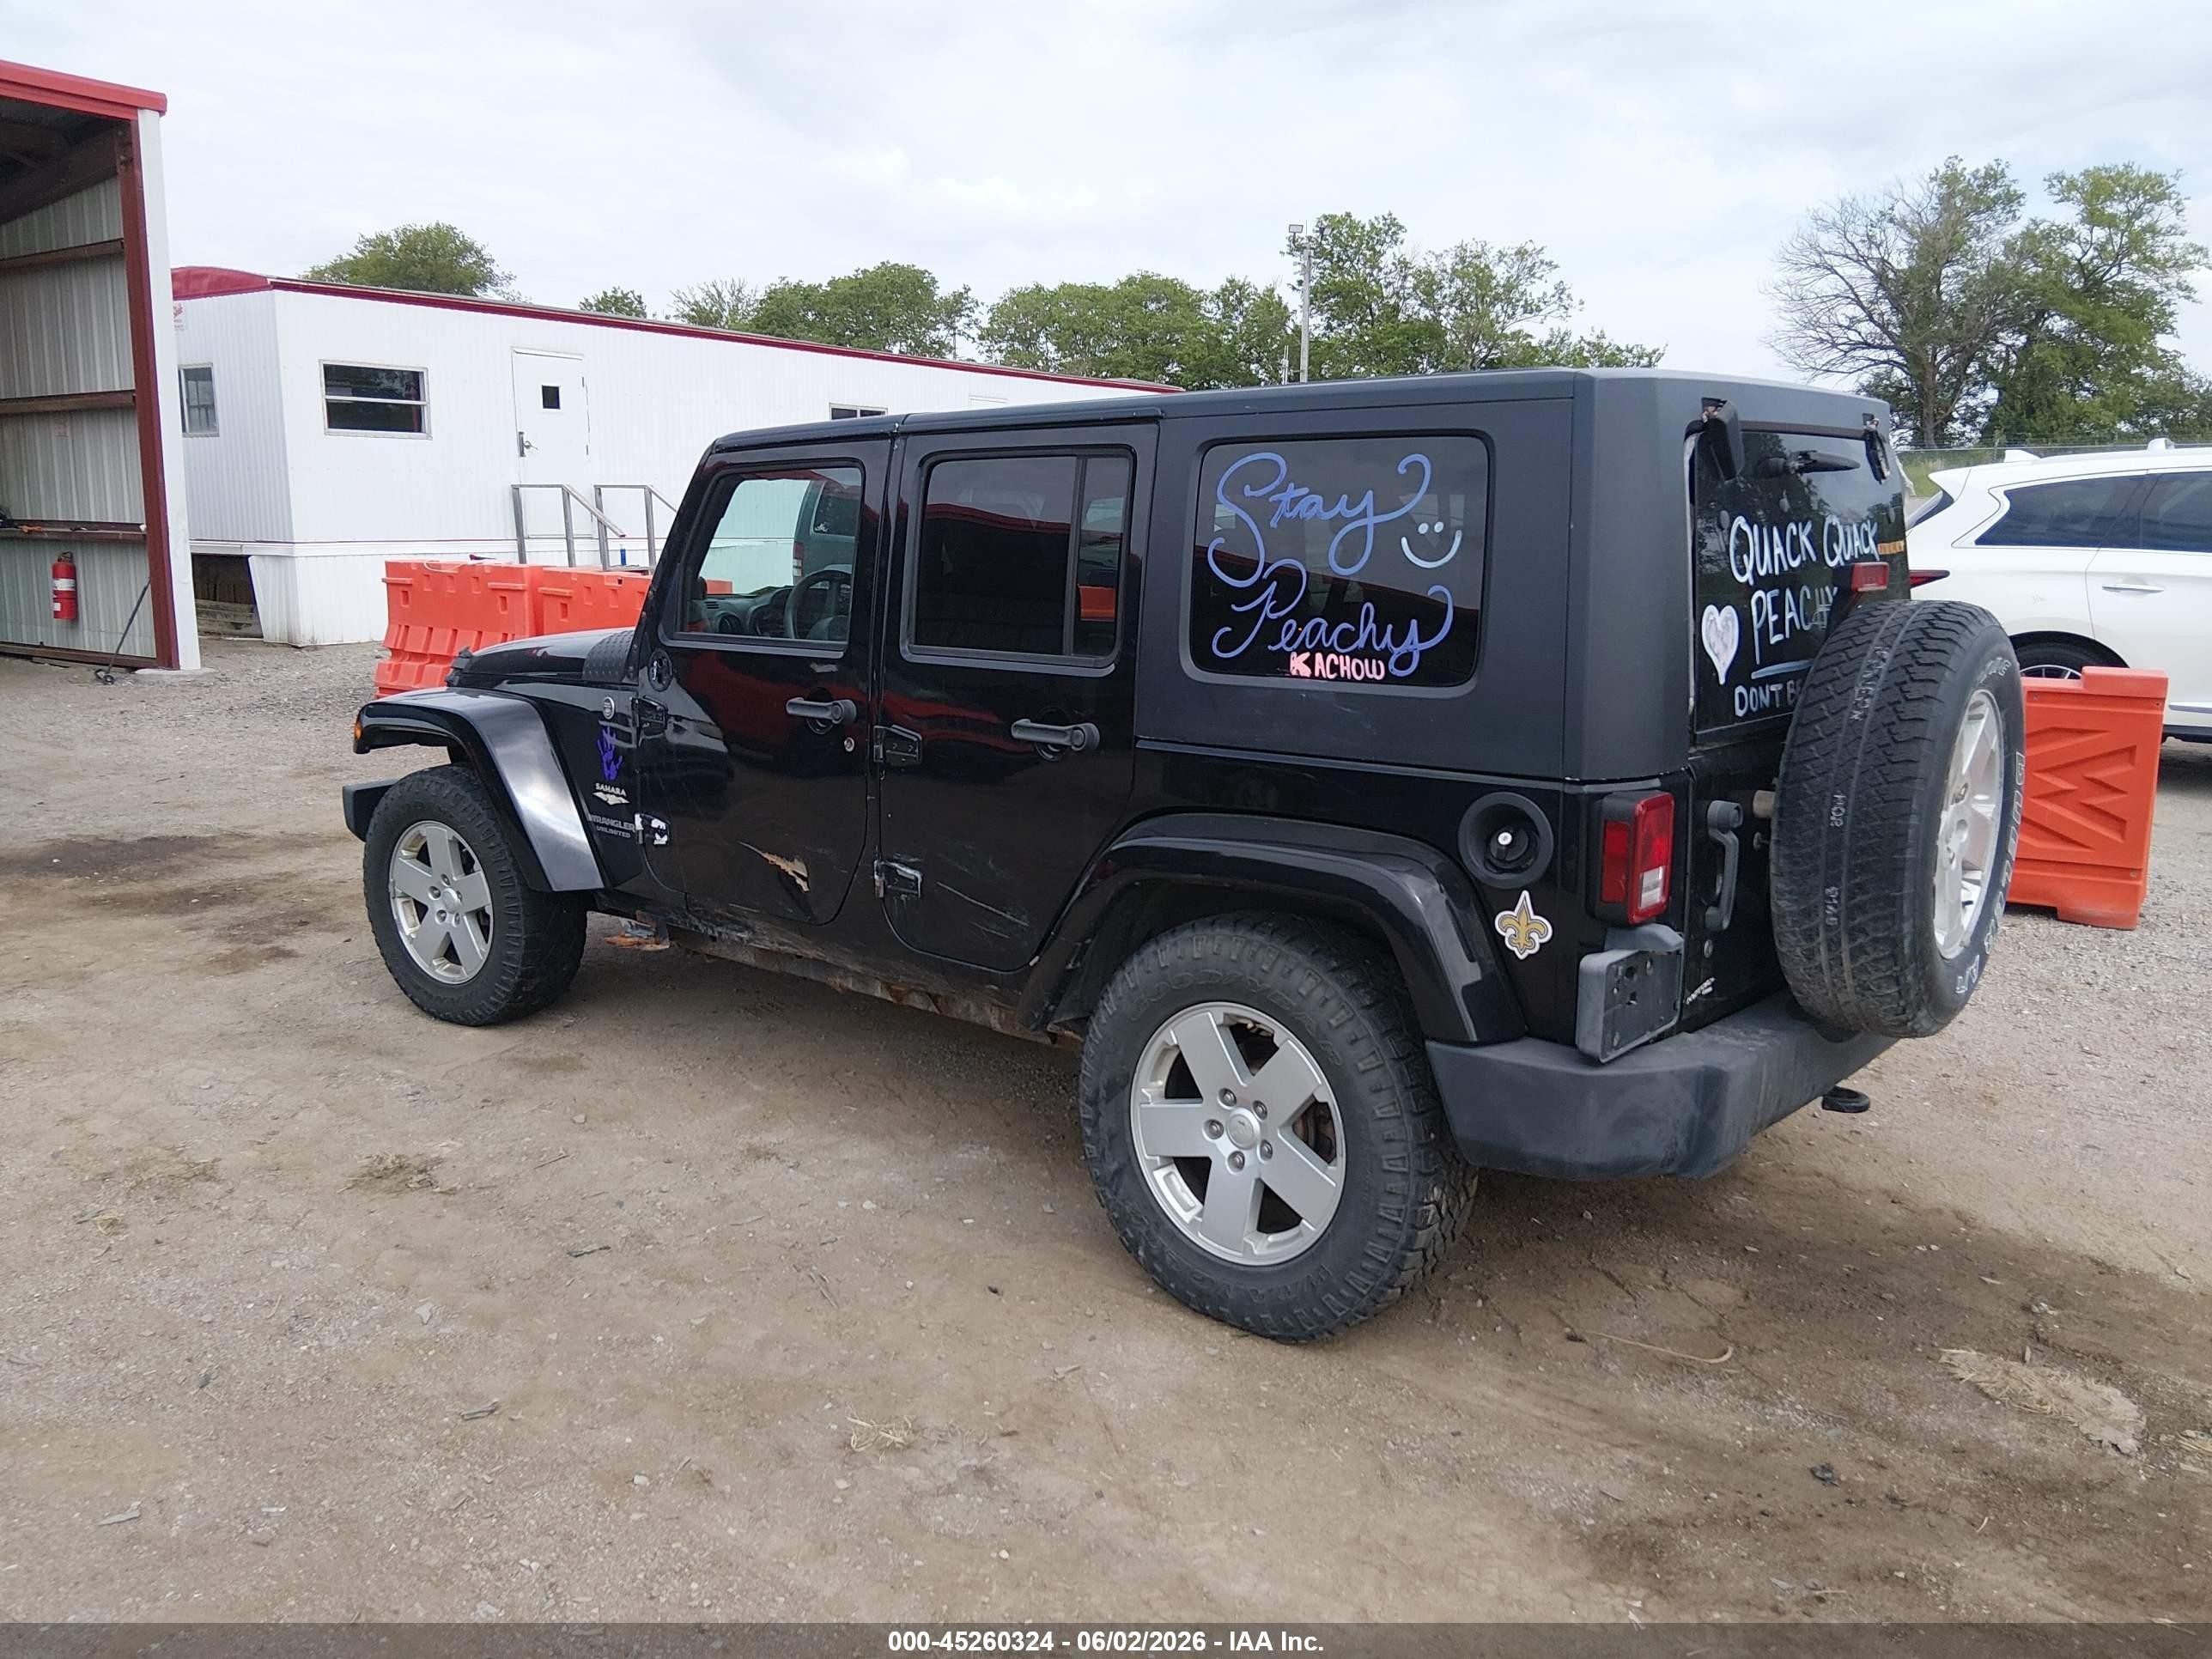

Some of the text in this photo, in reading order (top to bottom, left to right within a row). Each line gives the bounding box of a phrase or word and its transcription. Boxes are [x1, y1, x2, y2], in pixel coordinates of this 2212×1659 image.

[1207, 452, 1432, 588] Stay
[1729, 515, 1881, 586] QUACK QUACK
[1212, 558, 1454, 678] Peachy
[1289, 651, 1386, 681] KACHOW
[1734, 684, 1784, 718] DONT
[595, 782, 627, 797] SAHARA
[597, 825, 631, 839] UNLIMITED
